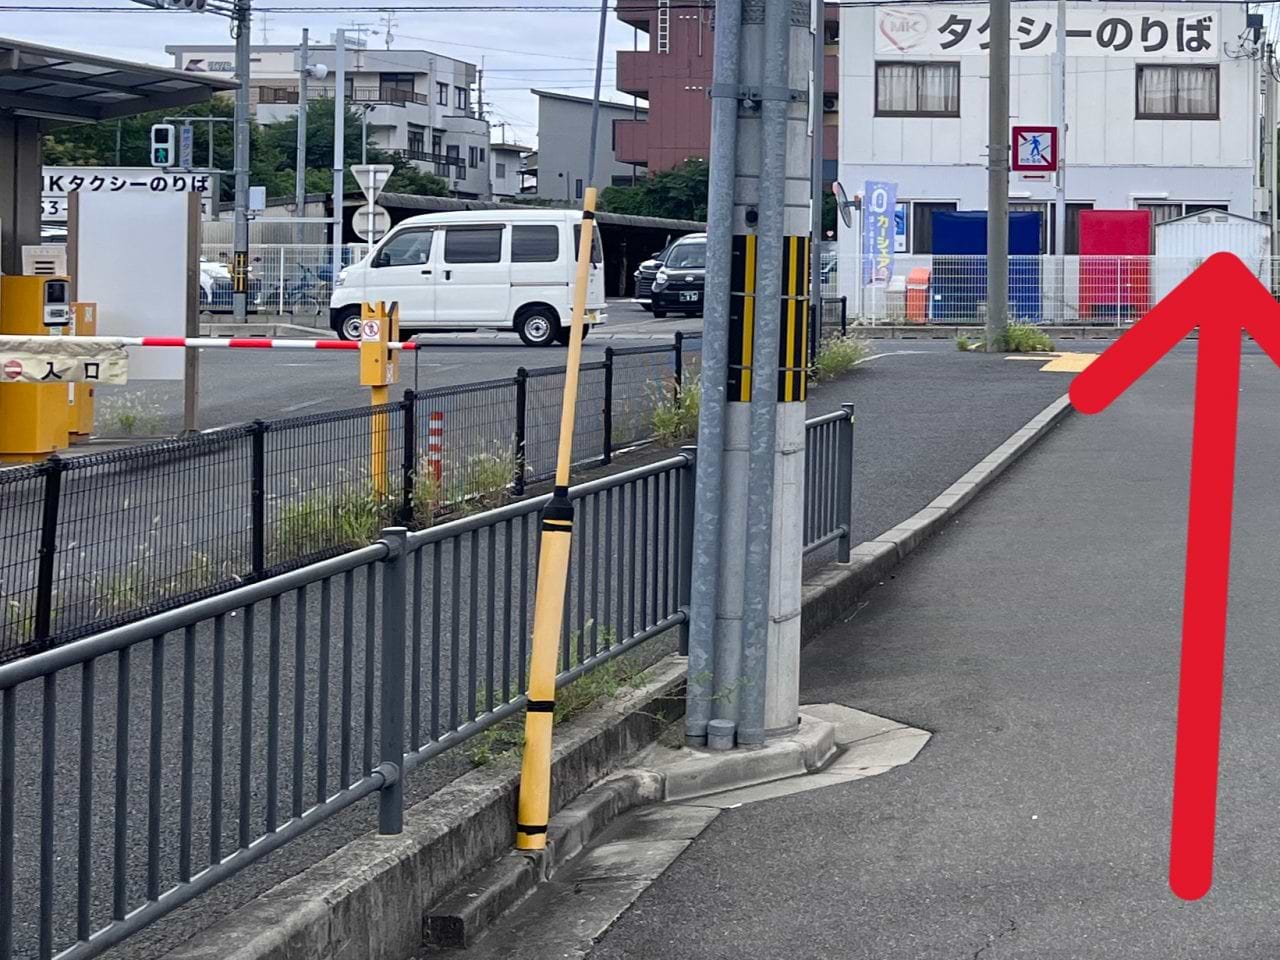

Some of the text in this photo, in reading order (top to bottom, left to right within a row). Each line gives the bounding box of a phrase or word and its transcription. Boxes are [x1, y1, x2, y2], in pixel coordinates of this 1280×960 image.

[42, 175, 209, 192] Kタクシーのりば
[41, 362, 100, 380] 入口
